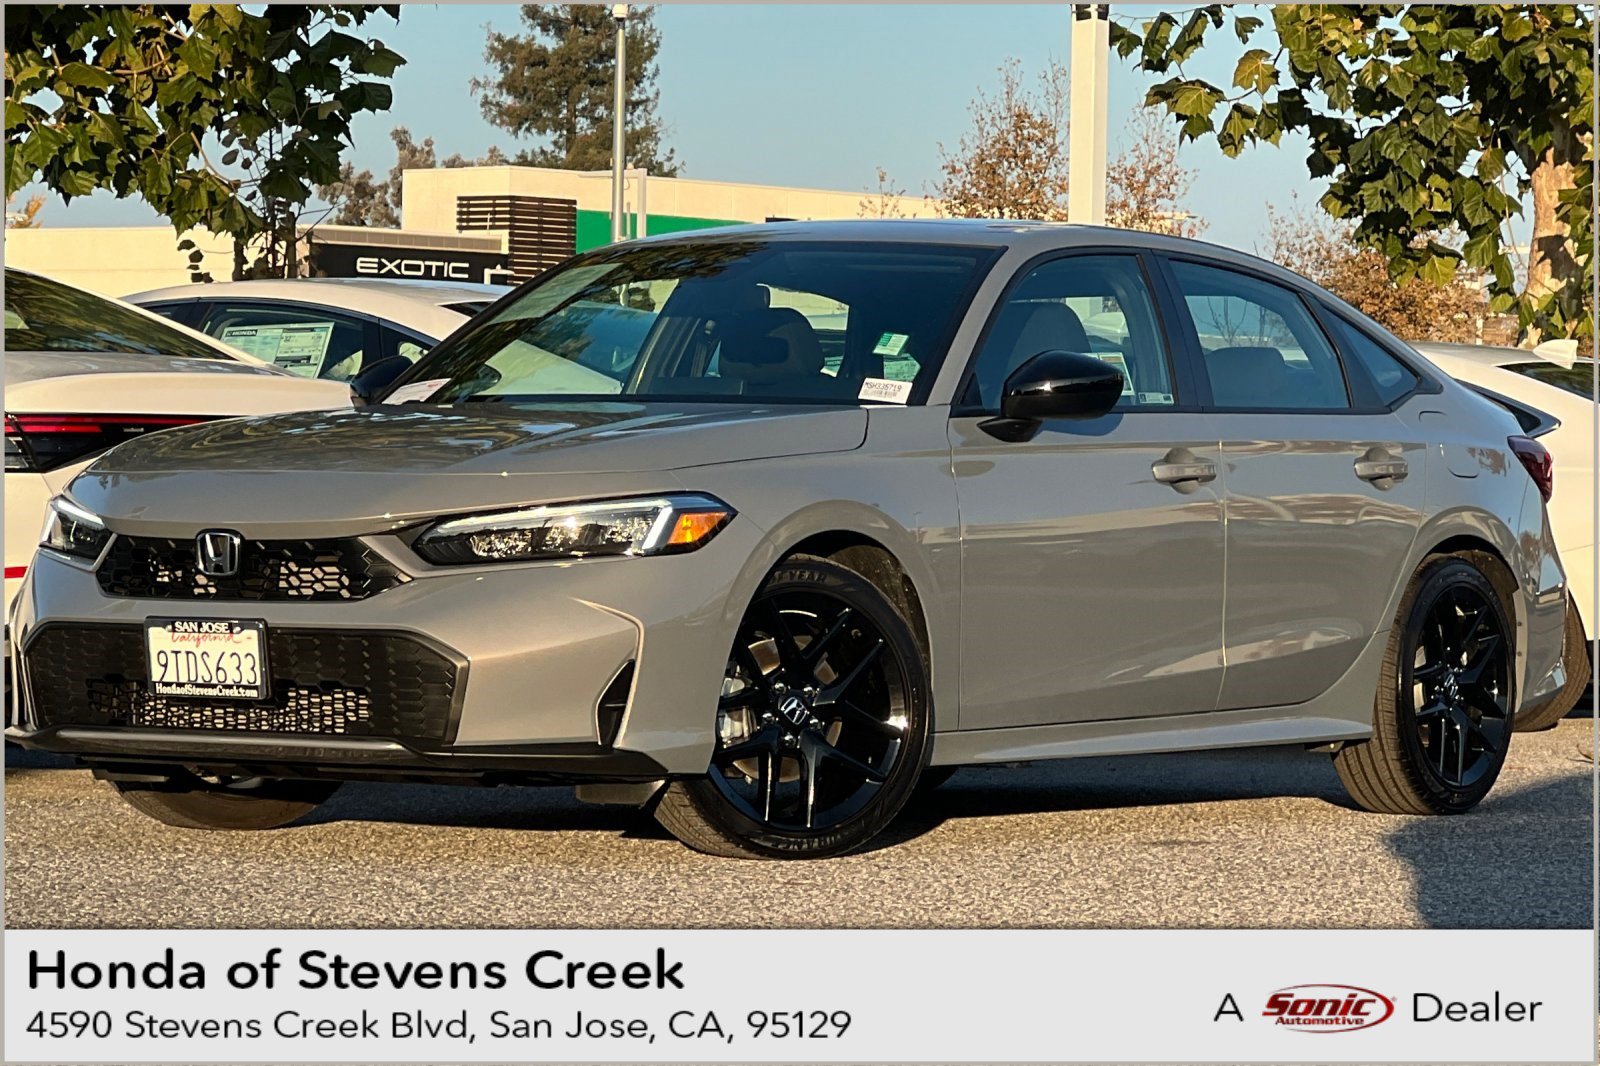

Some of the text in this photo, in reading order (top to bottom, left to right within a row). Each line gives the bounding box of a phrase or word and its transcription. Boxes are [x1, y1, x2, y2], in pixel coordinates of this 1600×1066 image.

[356, 256, 469, 279] EXOTIC
[174, 621, 230, 634] SAN JOSE
[156, 650, 257, 685] 9TDS633
